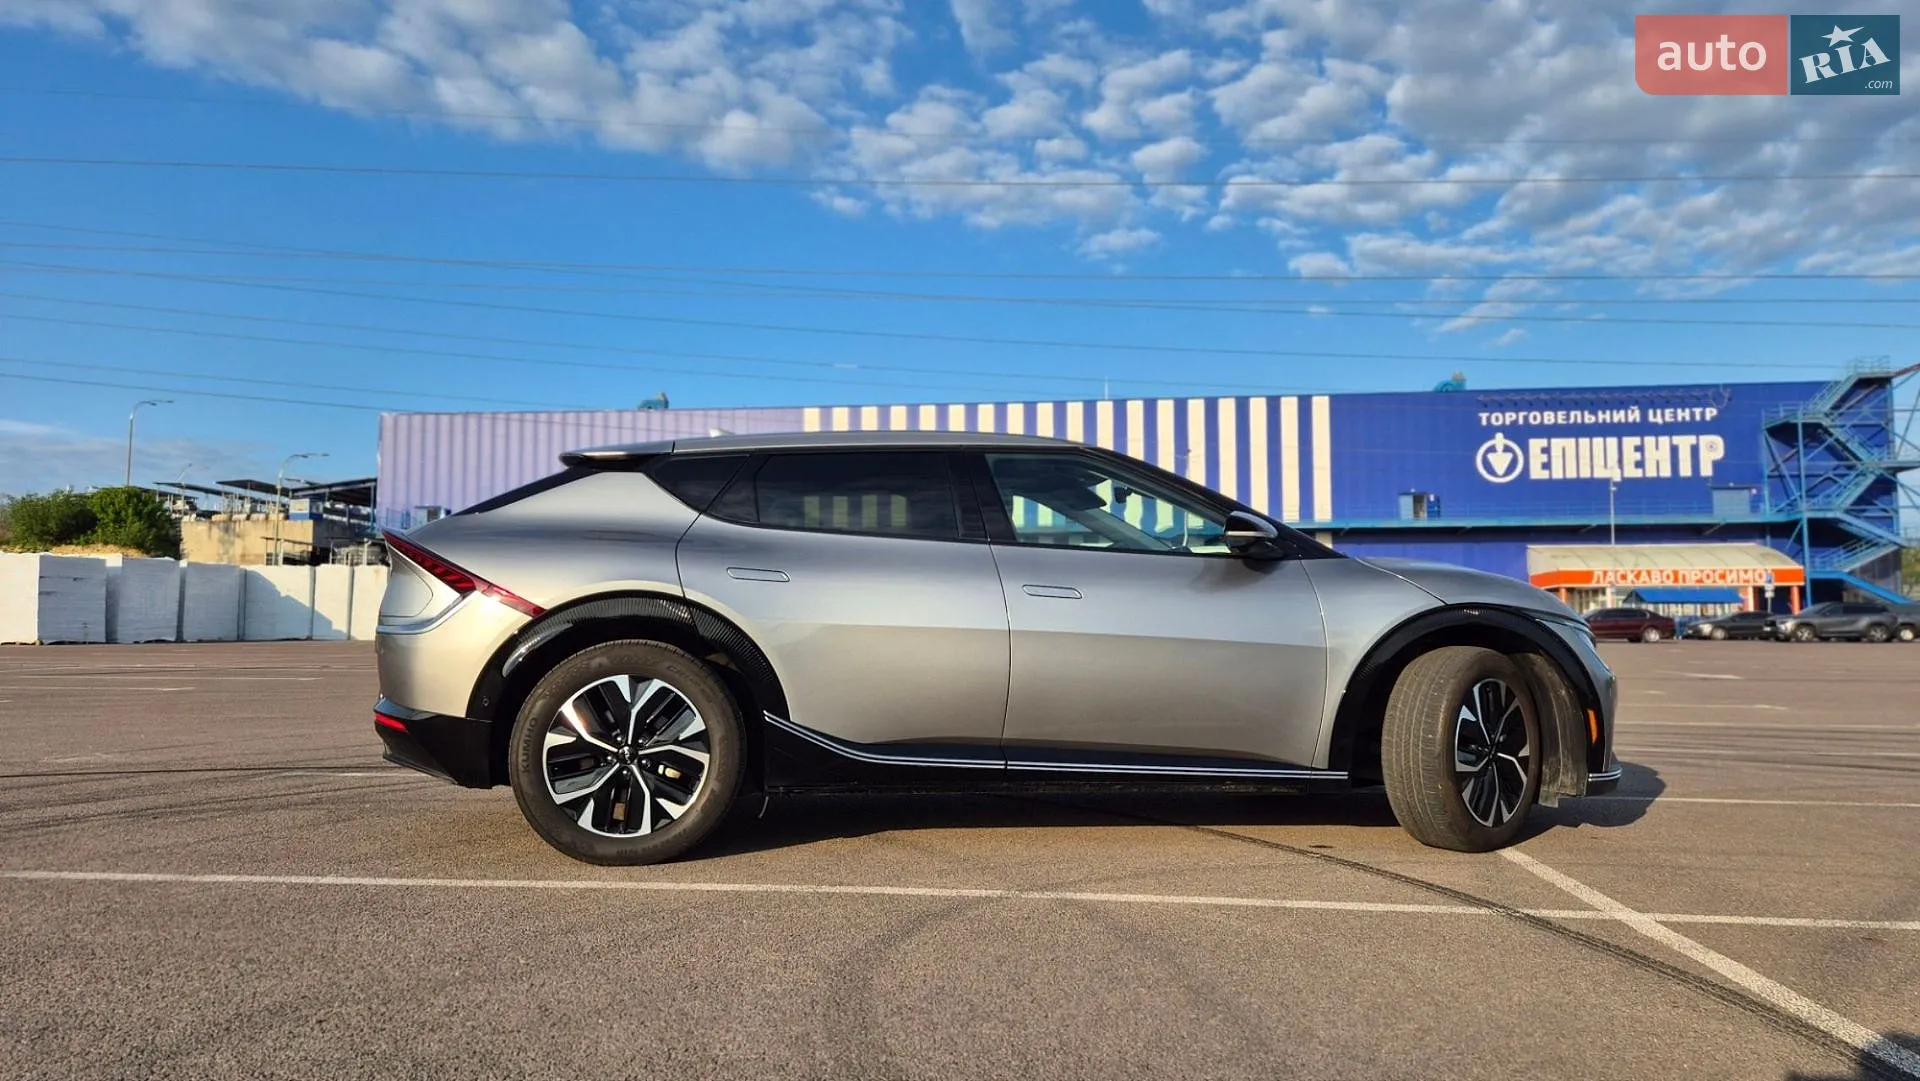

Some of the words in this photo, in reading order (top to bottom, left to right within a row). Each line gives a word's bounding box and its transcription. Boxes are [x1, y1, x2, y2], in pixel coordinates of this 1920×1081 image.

[1478, 406, 1641, 426] ТОРГОВЕЛЬНИЙ
[1648, 407, 1718, 425] ЦЕНТР
[1528, 434, 1725, 482] ЕПІЦЕНТР
[1591, 569, 1674, 585] ЛАСКАВО
[1678, 568, 1767, 584] ПРОСИМО
[521, 716, 537, 773] KUMHO
